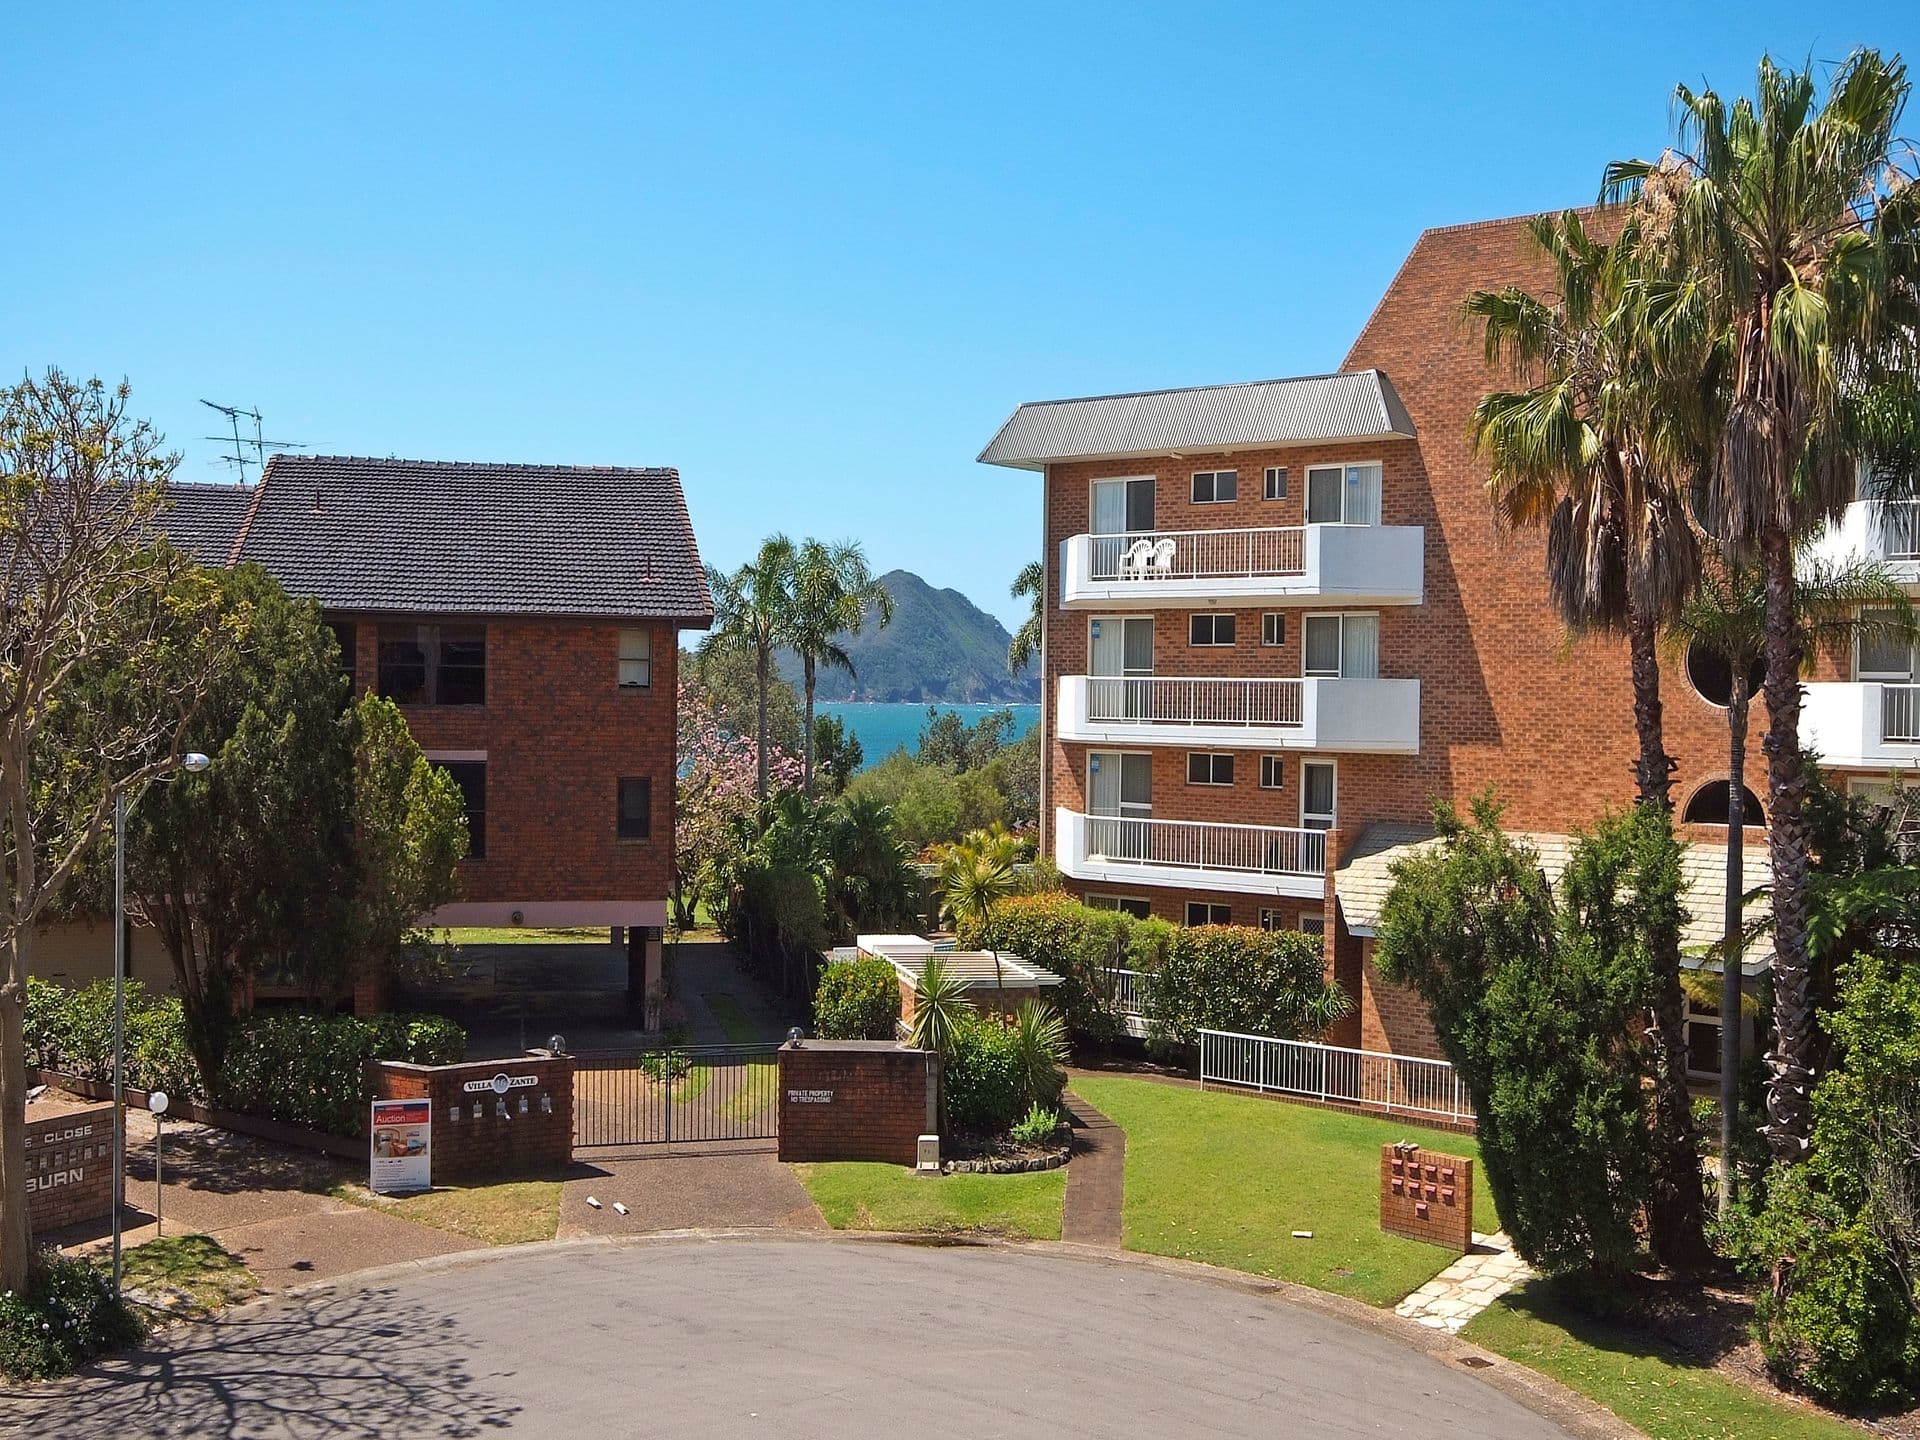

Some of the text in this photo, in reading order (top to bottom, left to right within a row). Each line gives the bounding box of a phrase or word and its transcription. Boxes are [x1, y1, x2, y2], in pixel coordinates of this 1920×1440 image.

[467, 1081, 493, 1090] VILLA
[509, 1077, 536, 1086] ZANTE
[376, 1114, 406, 1123] Auction
[44, 1125, 93, 1143] CLOSE
